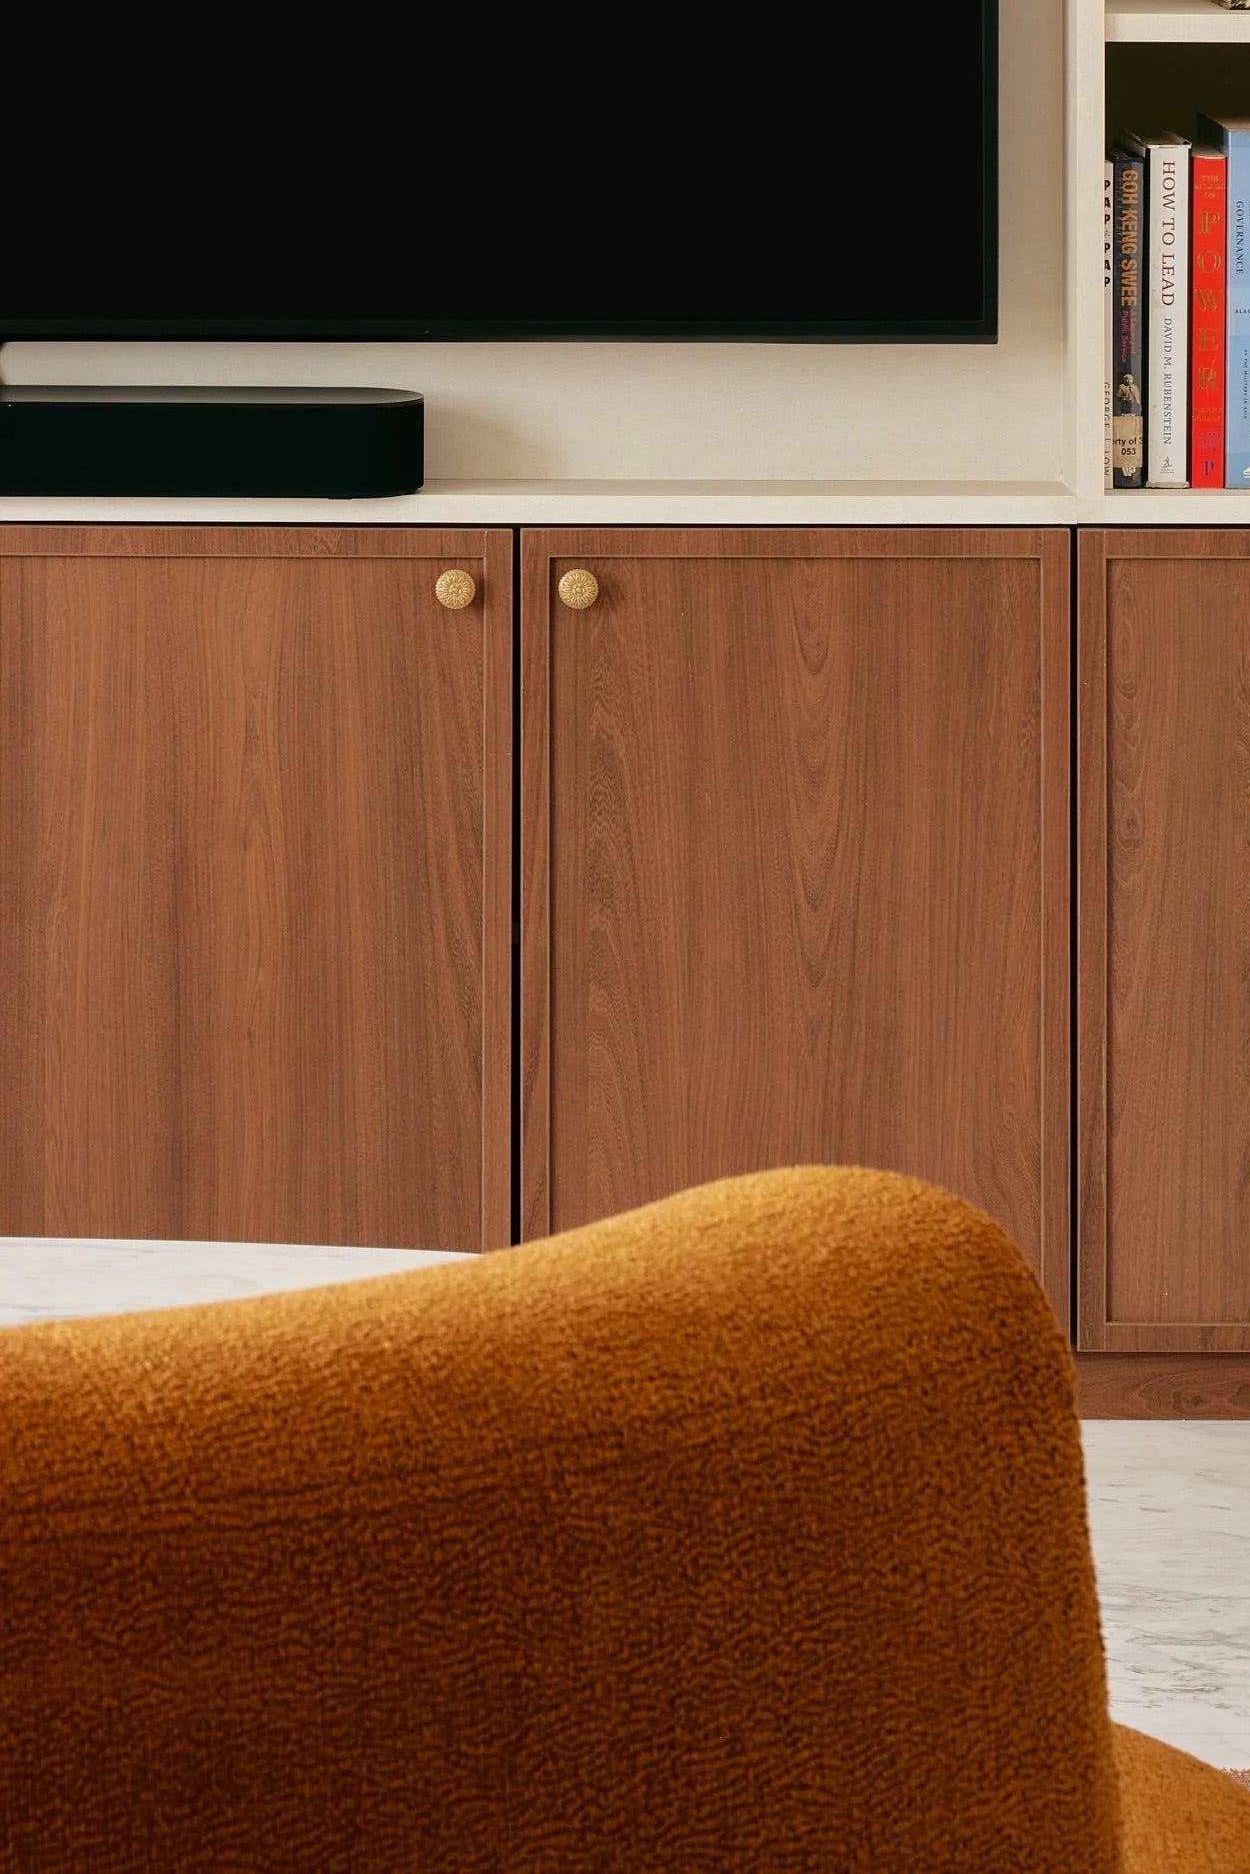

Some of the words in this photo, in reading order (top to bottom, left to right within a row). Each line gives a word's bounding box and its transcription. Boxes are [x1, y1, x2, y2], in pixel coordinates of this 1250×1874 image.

[1121, 169, 1138, 204] GOH
[1161, 160, 1177, 211] HOW
[1121, 210, 1138, 254] KENG
[1161, 218, 1176, 245] TO
[1236, 200, 1245, 275] GOVERNANCE
[1121, 259, 1138, 306] SWEE
[1160, 252, 1176, 306] LEAD
[1121, 448, 1136, 456] 053
